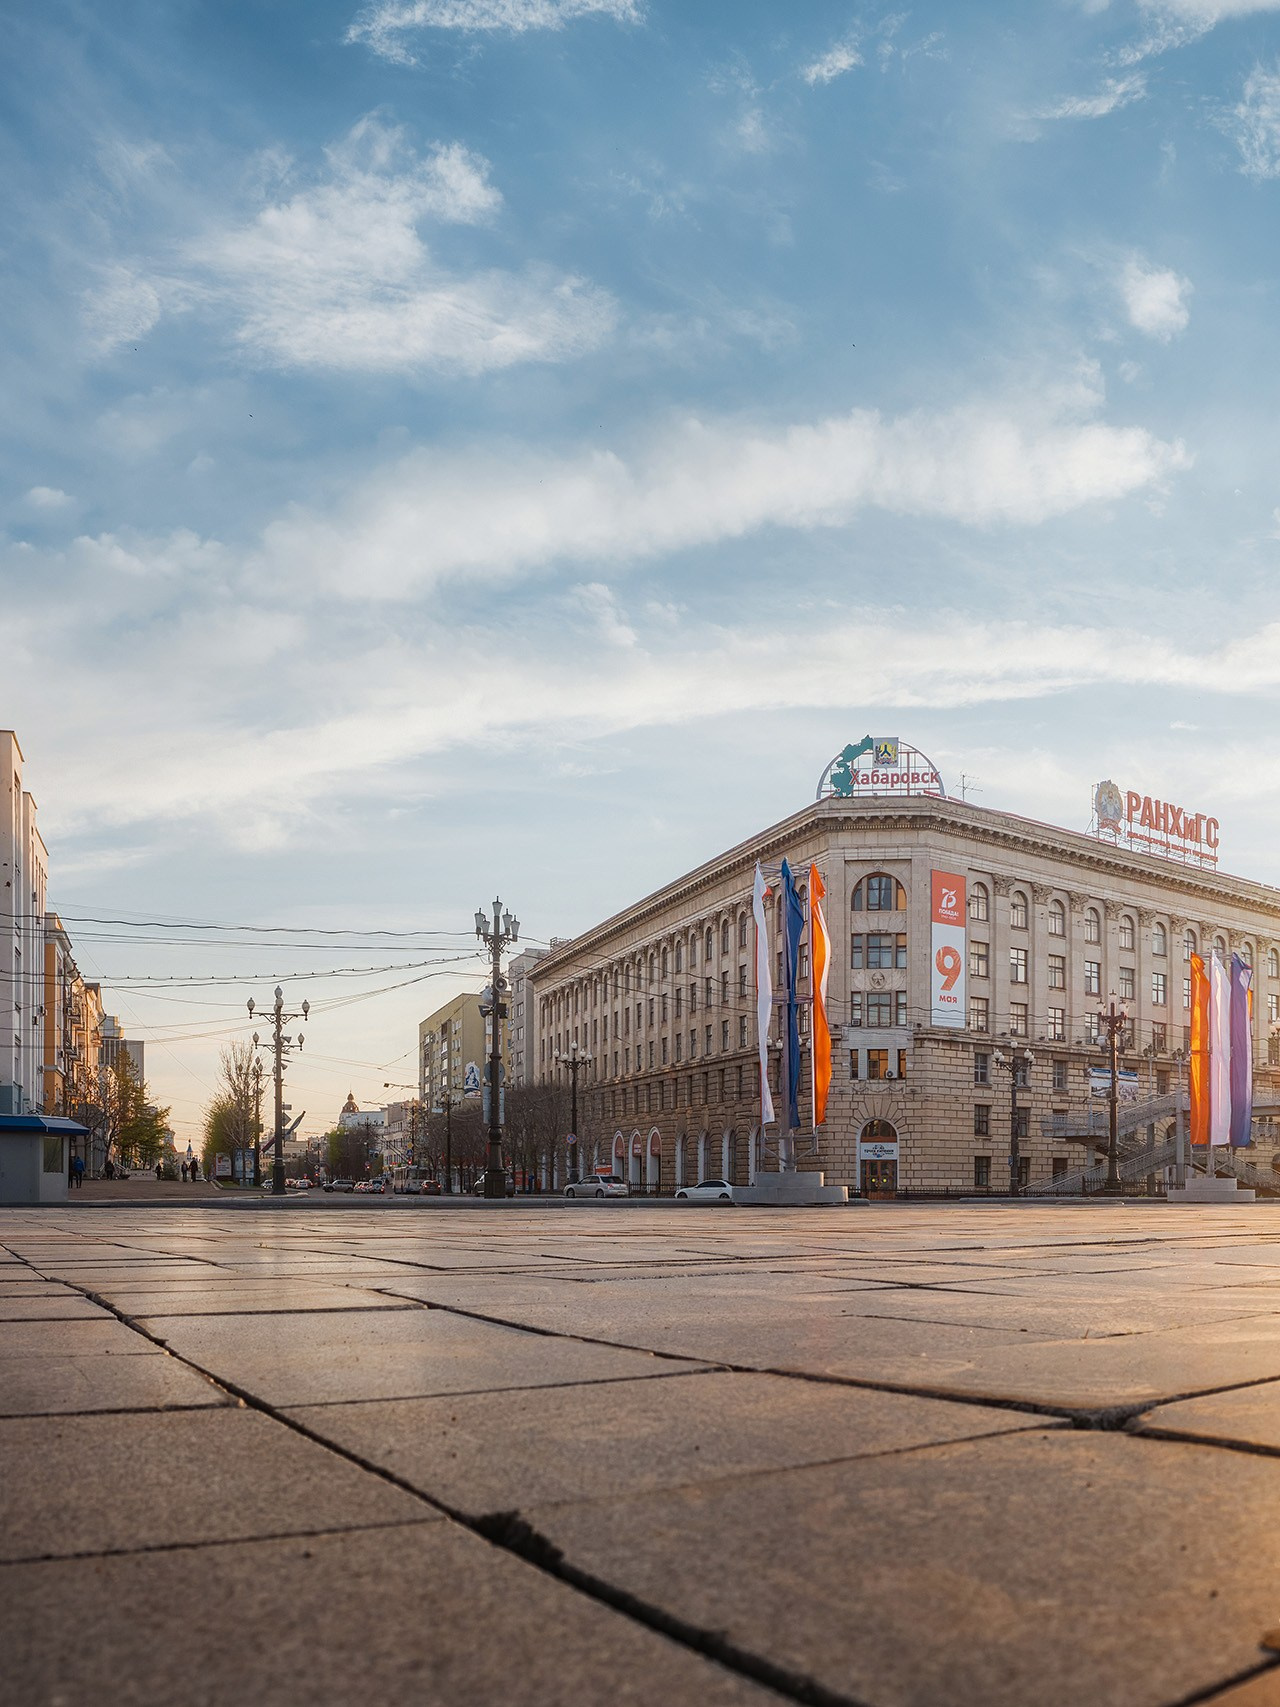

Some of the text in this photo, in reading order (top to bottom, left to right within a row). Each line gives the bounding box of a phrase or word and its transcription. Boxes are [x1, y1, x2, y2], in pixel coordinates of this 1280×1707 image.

[849, 769, 940, 788] Хабаровск
[1127, 790, 1219, 848] РАНХиГС
[935, 945, 961, 991] 9
